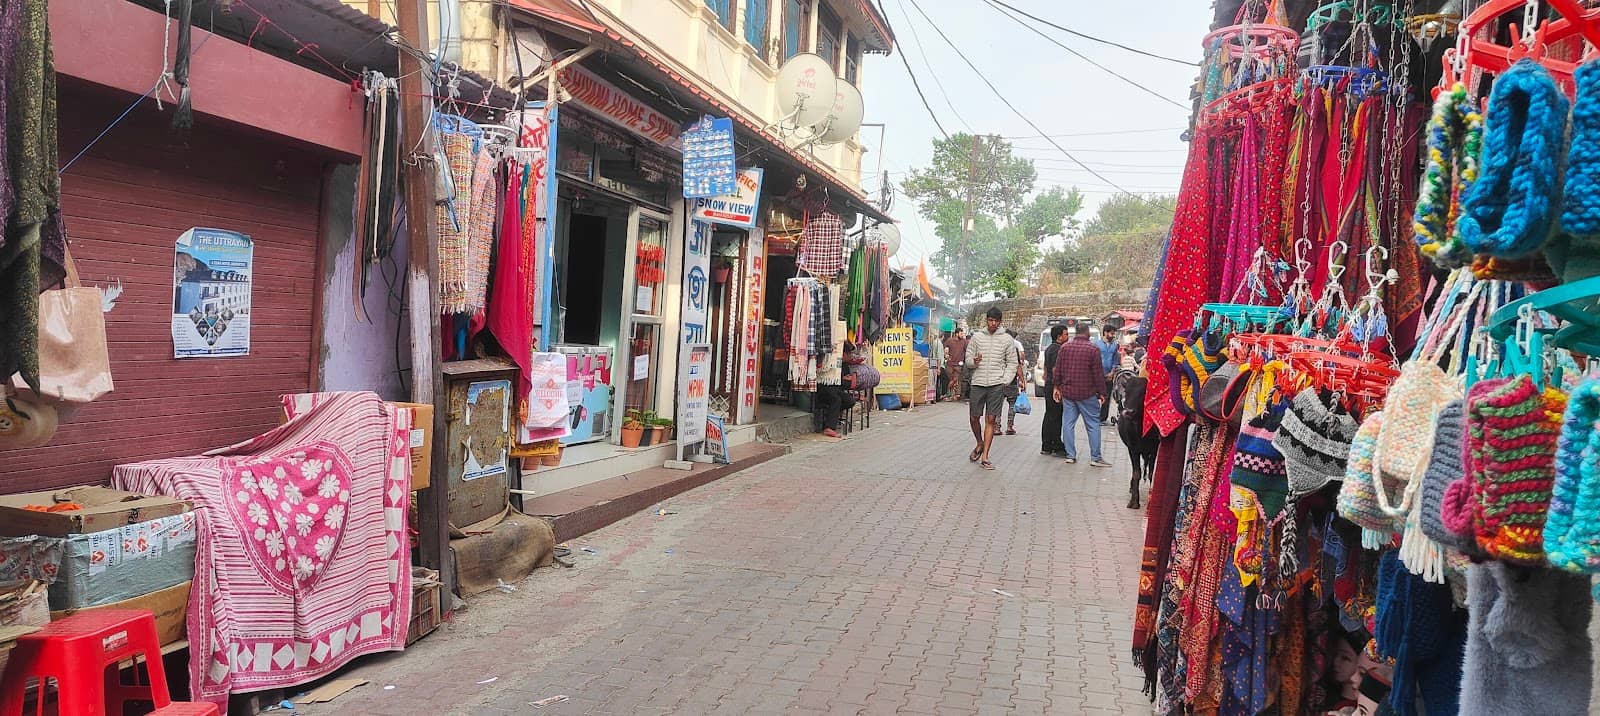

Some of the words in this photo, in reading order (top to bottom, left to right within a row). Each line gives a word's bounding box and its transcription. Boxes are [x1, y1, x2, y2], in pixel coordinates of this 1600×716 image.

[605, 93, 645, 127] HOME
[641, 113, 676, 141] STAY
[736, 171, 757, 191] FFICE
[697, 197, 726, 210] SNOW
[729, 202, 753, 215] VIEW
[199, 235, 213, 245] THE
[214, 237, 249, 247] UTTRAYAN
[884, 332, 911, 342] EM'S
[880, 345, 907, 355] HOME
[883, 358, 904, 367] STAY
